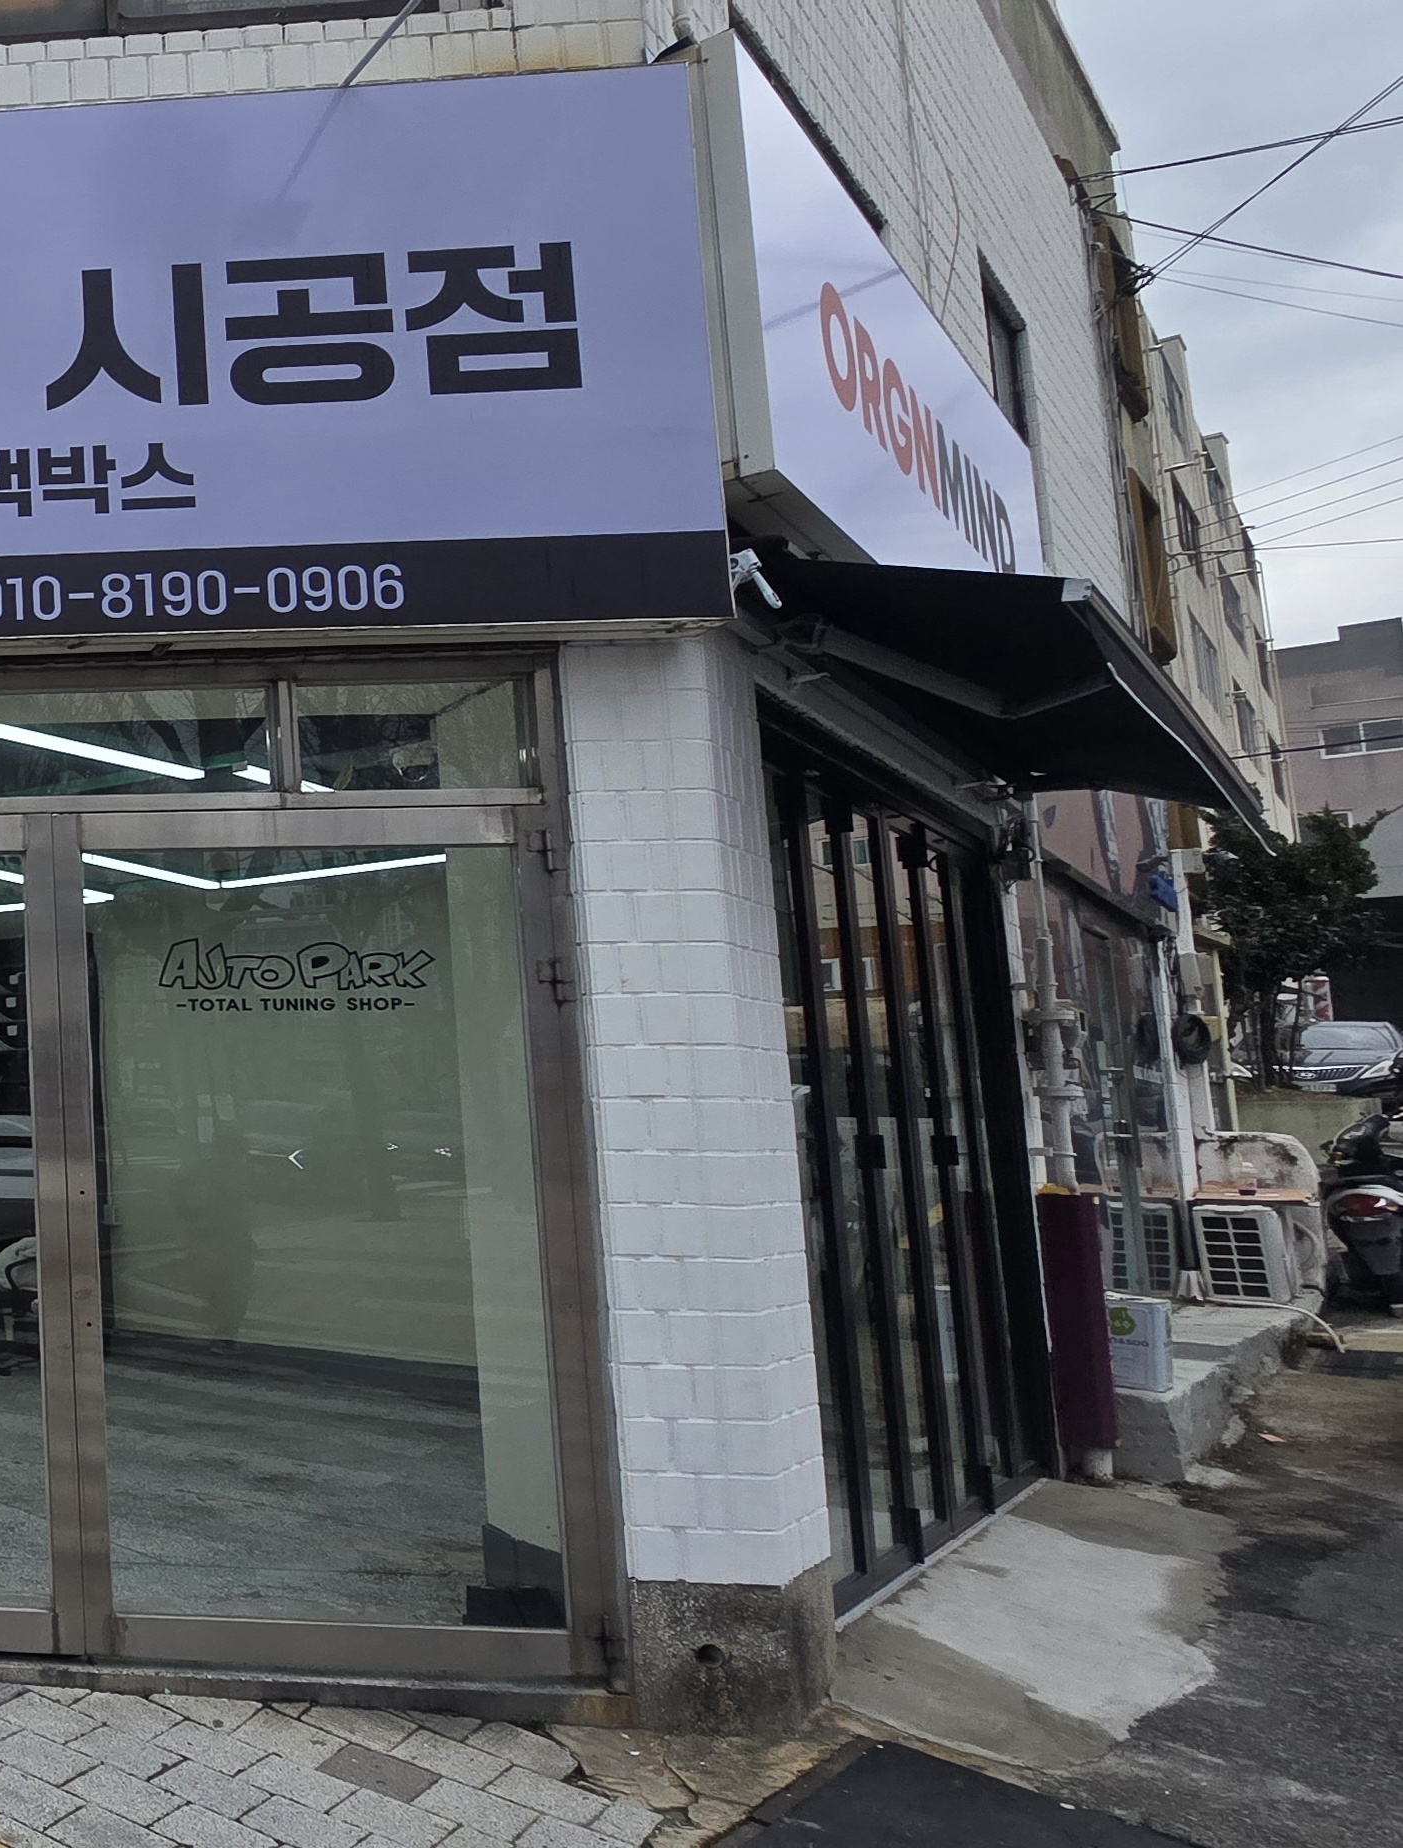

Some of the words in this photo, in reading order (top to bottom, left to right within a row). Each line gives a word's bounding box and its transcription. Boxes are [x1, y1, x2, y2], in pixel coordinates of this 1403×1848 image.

[46, 241, 584, 412] 시공점
[820, 281, 1017, 575] ORGNMIND
[259, 997, 337, 1012] TUNING
[296, 941, 436, 991] PARK
